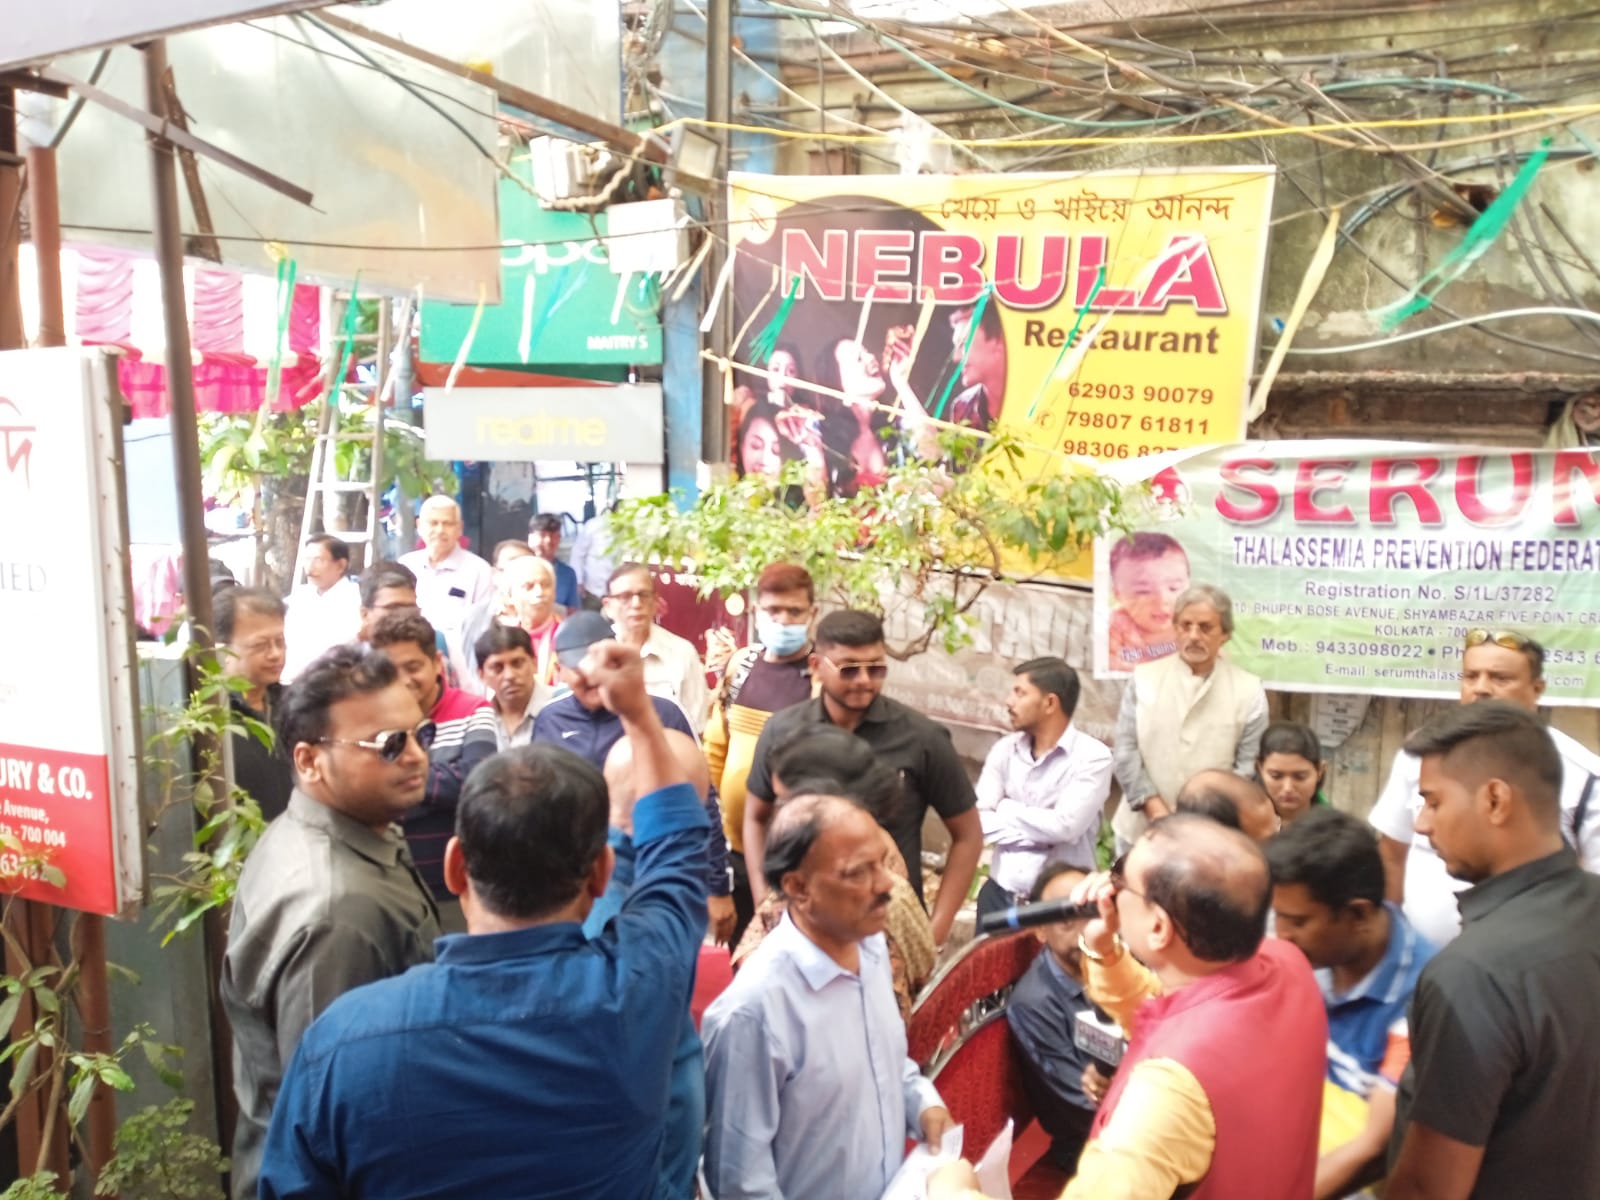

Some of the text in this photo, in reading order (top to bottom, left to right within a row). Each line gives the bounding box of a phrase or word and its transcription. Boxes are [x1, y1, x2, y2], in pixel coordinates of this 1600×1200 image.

[782, 229, 1229, 314] NEBULA
[1024, 319, 1220, 354] Restaurant
[1068, 381, 1215, 405] 62903 90079
[475, 408, 608, 447] realme
[1066, 411, 1210, 435] 79807 61811
[1063, 440, 1129, 459] 98306
[1233, 536, 1366, 569] THALASSEMIA
[1373, 538, 1501, 571] PREVENTION
[1305, 581, 1411, 600] Registration
[1418, 584, 1447, 601] No.
[1254, 602, 1303, 616] BHUPEN
[1307, 603, 1340, 617] BOSE
[1404, 608, 1495, 621] SHYAMBAZAR
[1500, 610, 1528, 623] FIVE
[1533, 611, 1574, 624] POINT
[1375, 624, 1434, 638] KOLKATA
[1316, 640, 1424, 659] 9433098022
[37, 762, 55, 795] &
[58, 765, 93, 800] CO.
[4, 798, 50, 824] Avenue,
[20, 824, 42, 843] 700
[43, 828, 66, 849] 004
